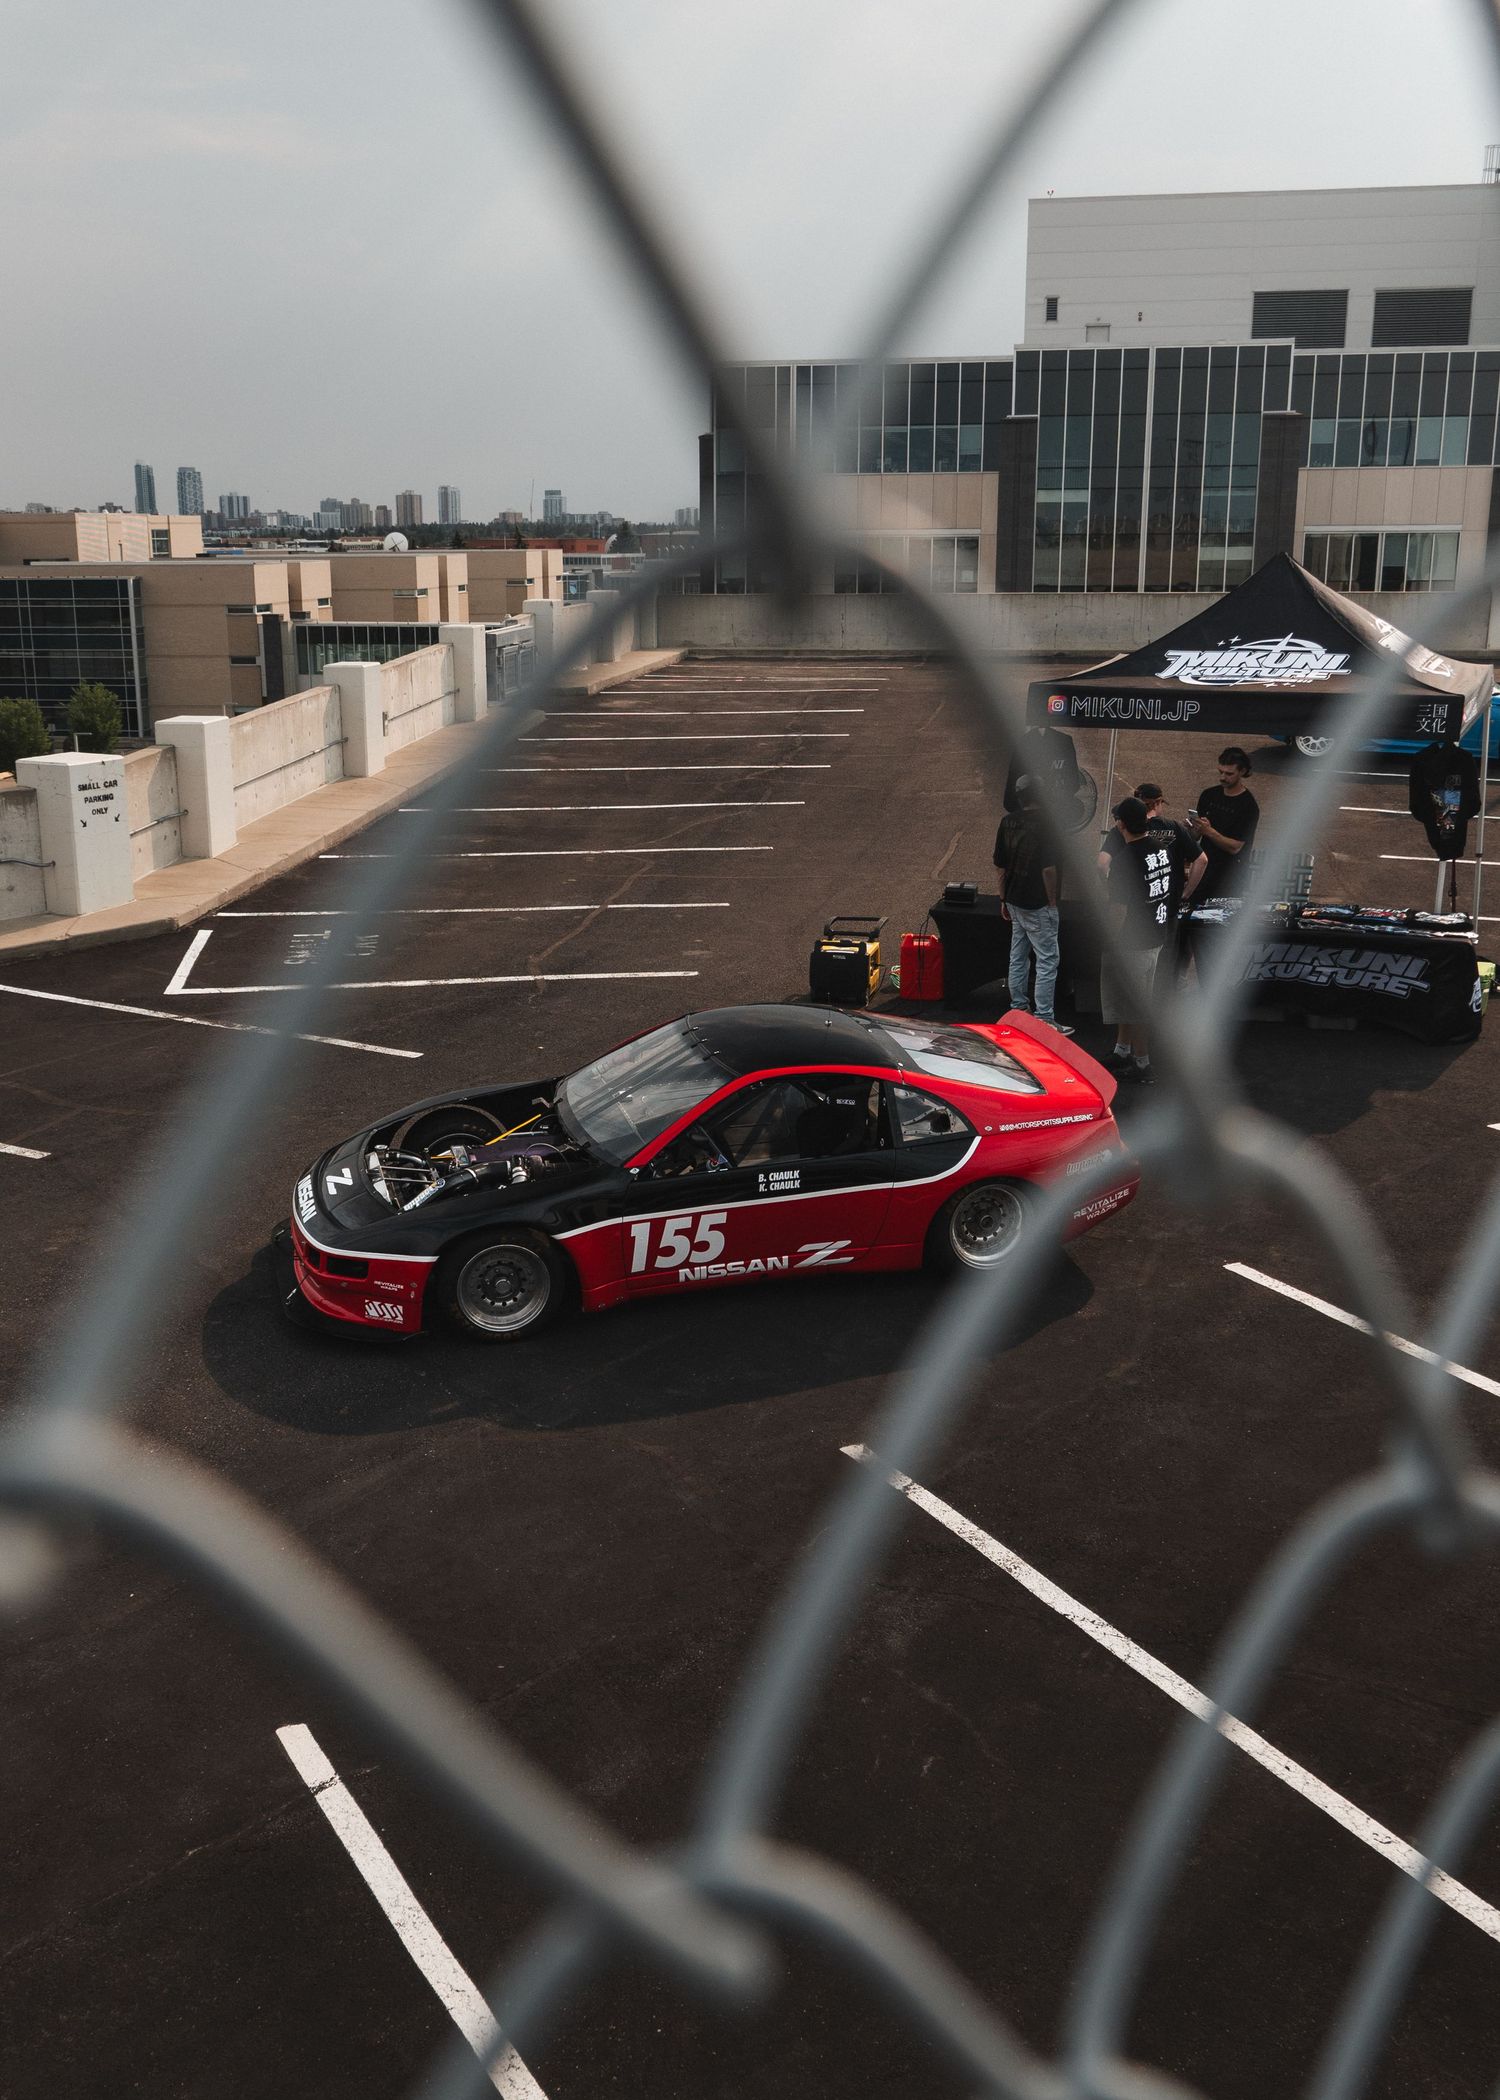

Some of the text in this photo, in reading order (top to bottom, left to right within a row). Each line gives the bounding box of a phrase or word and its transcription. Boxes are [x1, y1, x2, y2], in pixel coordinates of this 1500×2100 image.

[1155, 649, 1351, 680] MIKUNI
[1180, 666, 1351, 680] KULTURE
[1071, 696, 1200, 721] MIKUNI.JP
[1416, 704, 1448, 719] 三国
[1416, 718, 1446, 733] 文化
[78, 779, 118, 791] SMALL CAR
[84, 793, 114, 804] PARKING
[91, 807, 108, 815] ONLY
[1145, 849, 1170, 871] 東京
[1249, 943, 1430, 979] MIKUNI
[1247, 962, 1430, 997] KULTURE
[758, 1169, 800, 1183] B. CHAULK
[759, 1179, 801, 1192] K. CHAULK
[297, 1174, 318, 1224] NISSAN
[1073, 1188, 1129, 1219] REVITALIZE
[1086, 1202, 1118, 1220] WRAPS
[631, 1211, 728, 1273] 155
[679, 1240, 855, 1282] NISSAN Z
